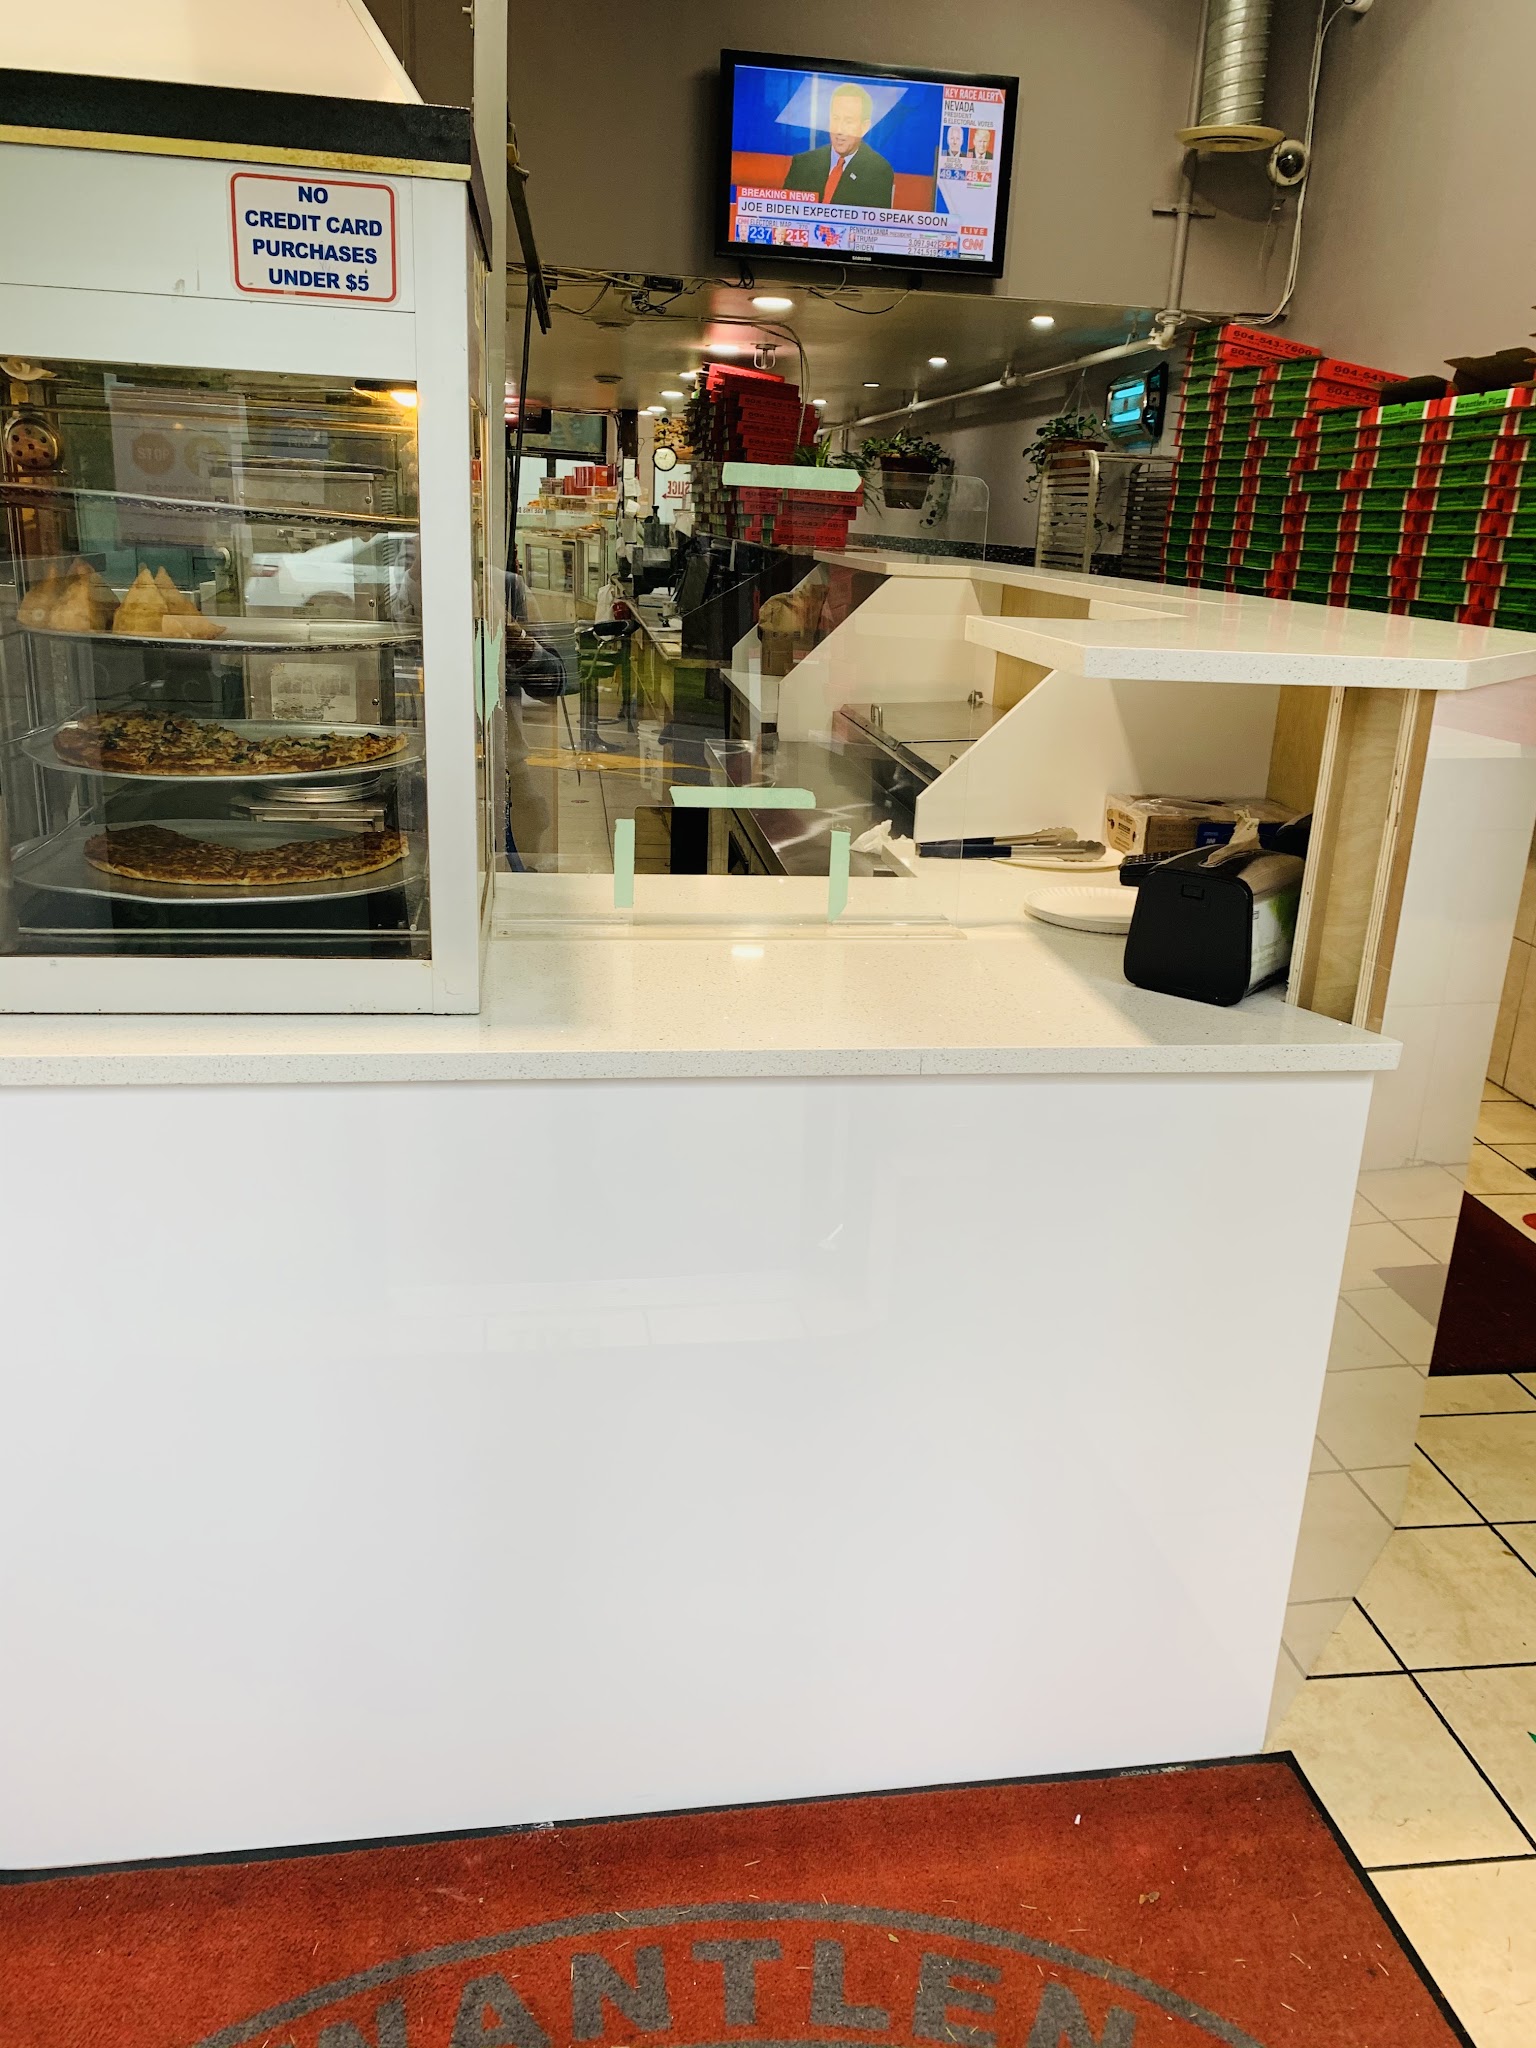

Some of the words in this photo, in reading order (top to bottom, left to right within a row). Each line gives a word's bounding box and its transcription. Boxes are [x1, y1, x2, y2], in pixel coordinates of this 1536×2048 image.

[945, 87, 958, 98] KEY
[959, 88, 978, 100] RACE
[978, 89, 999, 101] ALERT
[944, 100, 975, 113] NEVADA
[298, 185, 328, 204] NO
[741, 187, 787, 200] BREAKING
[789, 191, 816, 202] NEWS
[741, 202, 763, 213] JOE
[766, 203, 799, 215] BIDEN
[803, 206, 859, 220] EXPECTED
[862, 210, 876, 221] TO
[879, 212, 915, 224] SPEAK
[917, 215, 948, 227] SOON
[244, 209, 321, 231] CREDIT
[326, 216, 382, 237] CARD
[749, 226, 772, 239] 237
[786, 229, 809, 242] 213
[963, 227, 985, 235] LIVE
[252, 238, 377, 265] PURCHASES
[856, 243, 875, 251] BIDEN
[962, 238, 984, 251] CNN
[269, 267, 340, 289] UNDER
[346, 273, 369, 293] $5
[1233, 329, 1314, 357] 604-543-7600
[136, 447, 170, 461] STOP
